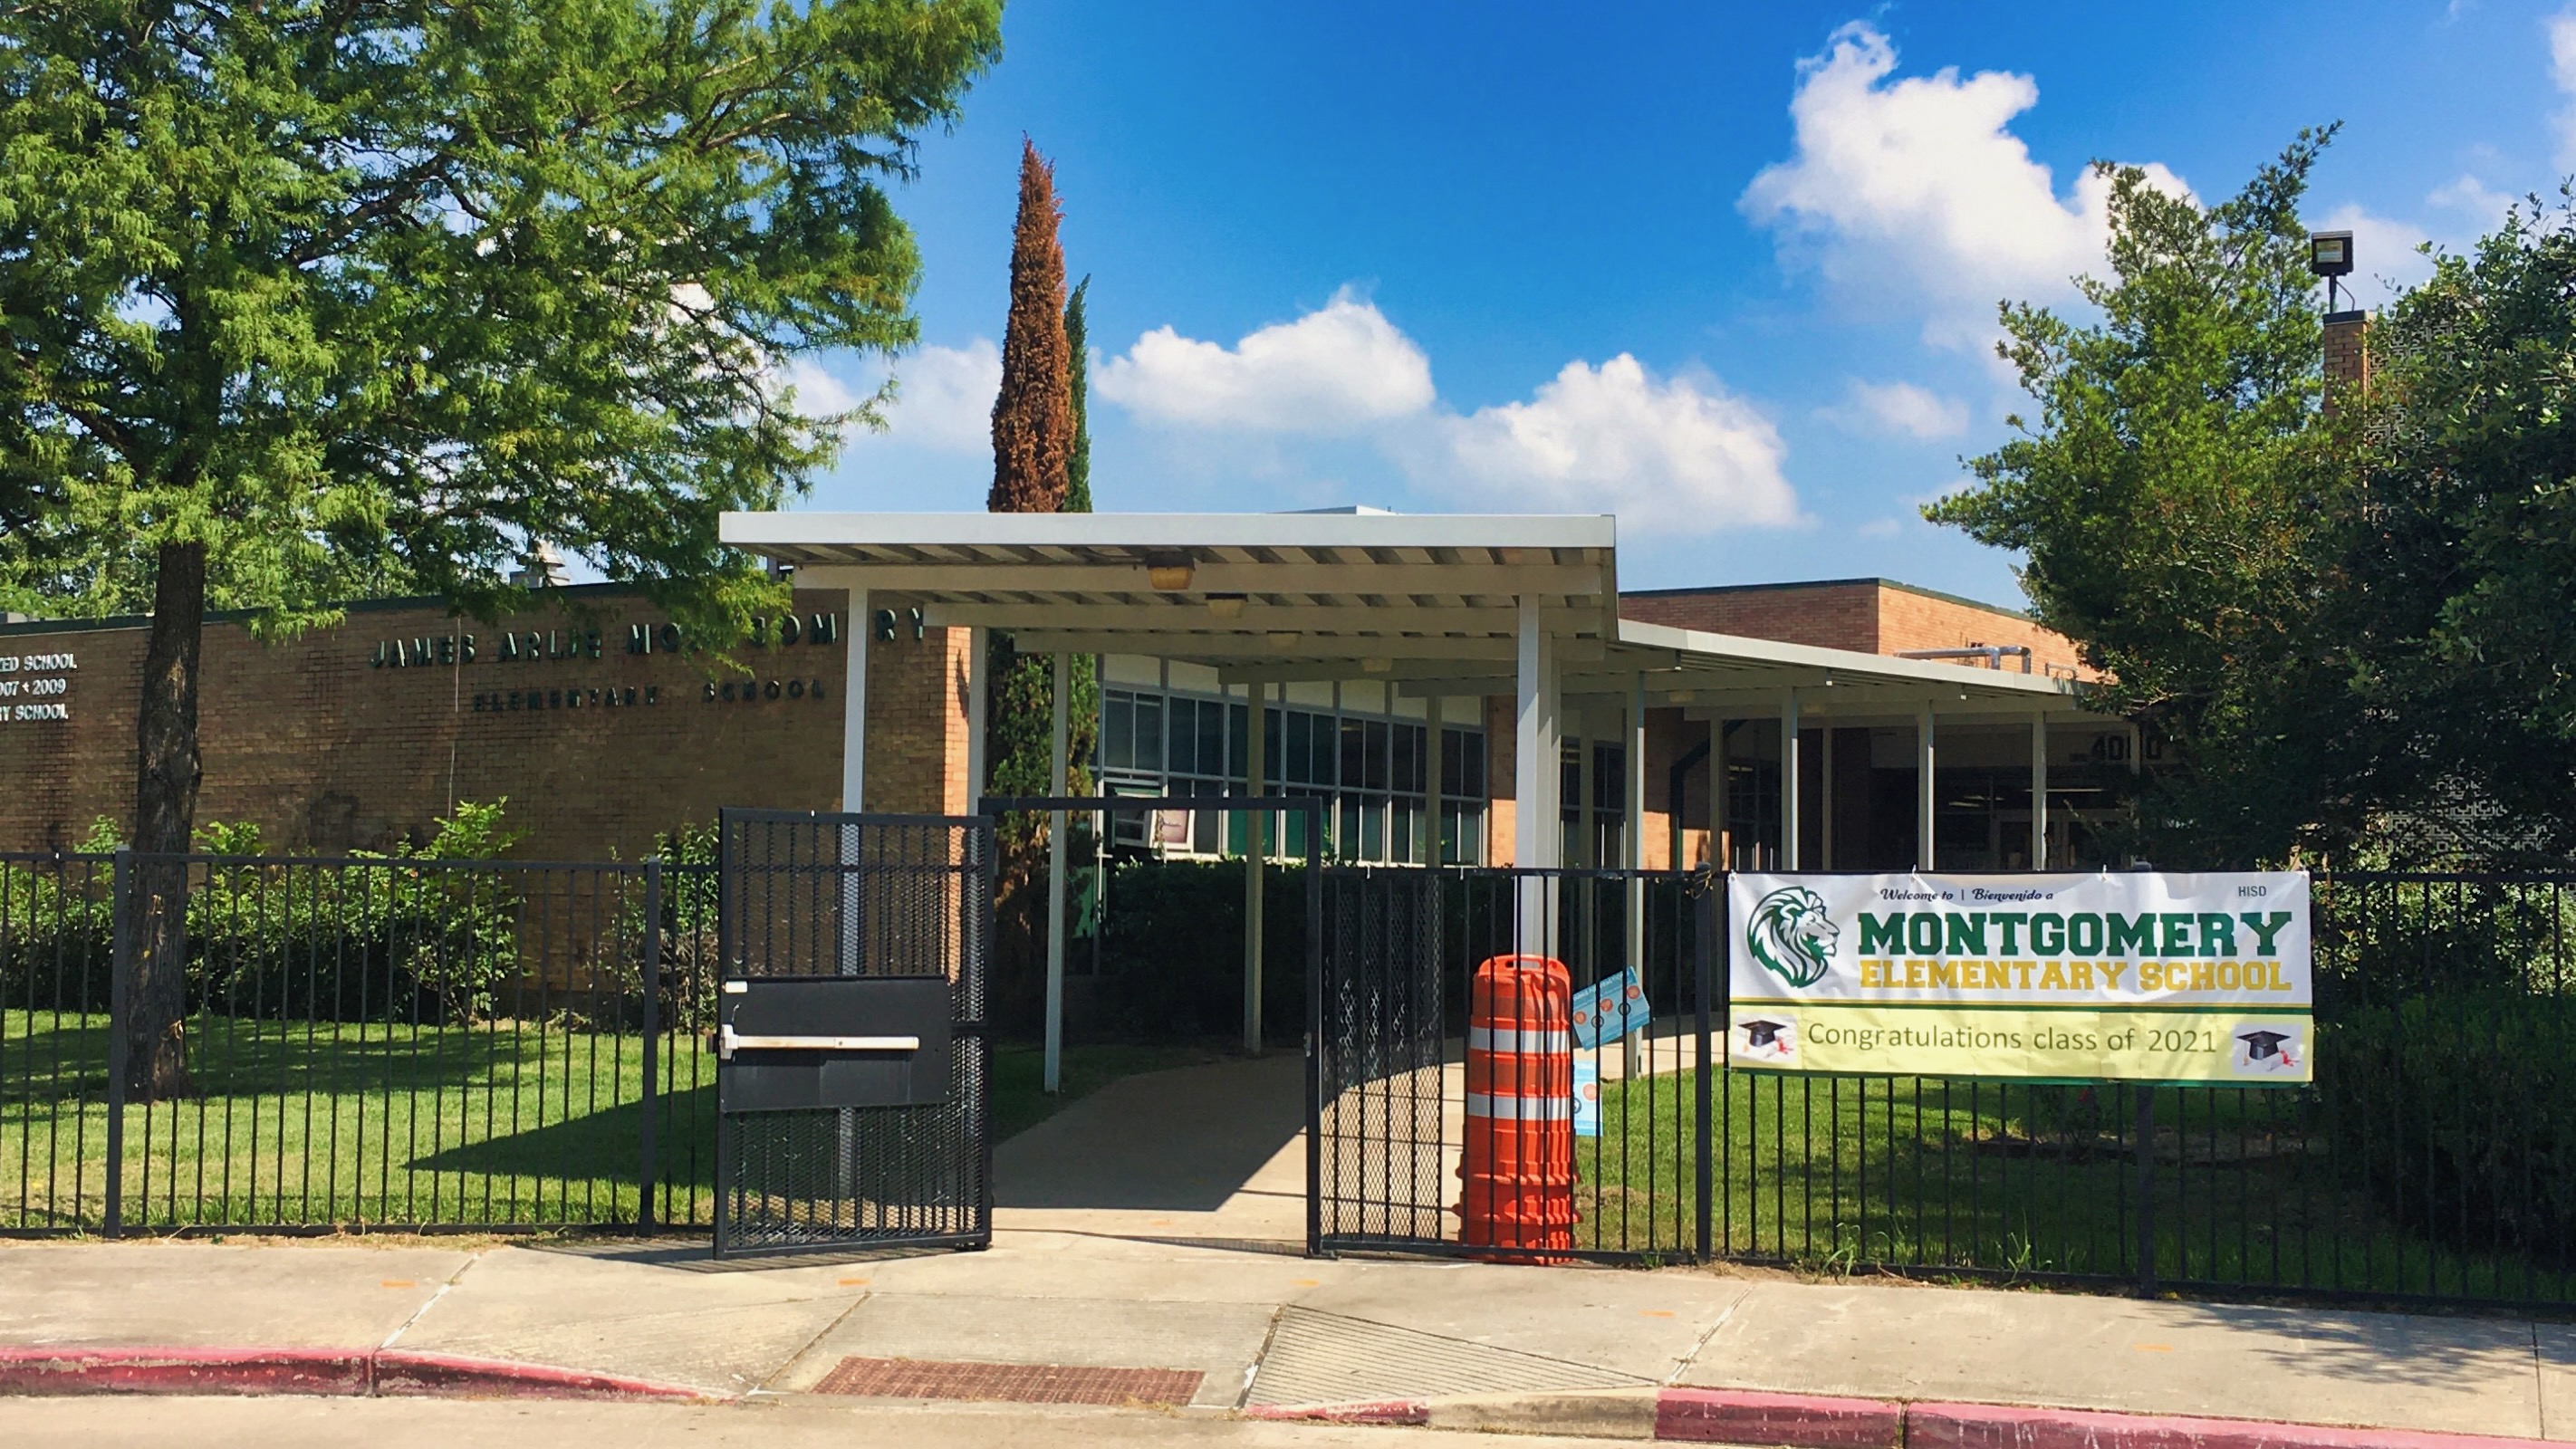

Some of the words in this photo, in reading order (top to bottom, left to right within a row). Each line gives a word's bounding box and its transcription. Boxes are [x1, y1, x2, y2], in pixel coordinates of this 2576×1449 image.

[370, 633, 476, 668] JAMES
[498, 628, 602, 661] ARLIE
[626, 606, 925, 654] MOGOMRY
[24, 653, 78, 671] SCHOOL
[33, 677, 67, 696] 2009
[472, 686, 658, 713] ELEMENTARY
[702, 679, 825, 705] SCHOOL
[14, 703, 69, 722] SCHOOL
[2091, 734, 2162, 761] 400
[1880, 888, 1938, 902] Welcome
[1941, 889, 1954, 901] to
[1971, 888, 2043, 903] Bienvenido
[2045, 891, 2054, 901] a
[2238, 886, 2267, 897] HISD
[1858, 911, 2292, 957] MONTGOMERY
[1860, 960, 2129, 991] ELEMENTARY
[2139, 961, 2292, 992] SCHOOL
[1807, 1022, 2023, 1051] Congratulations
[2033, 1026, 2098, 1051] class
[2107, 1027, 2136, 1051] of
[2148, 1029, 2217, 1053] 2021
